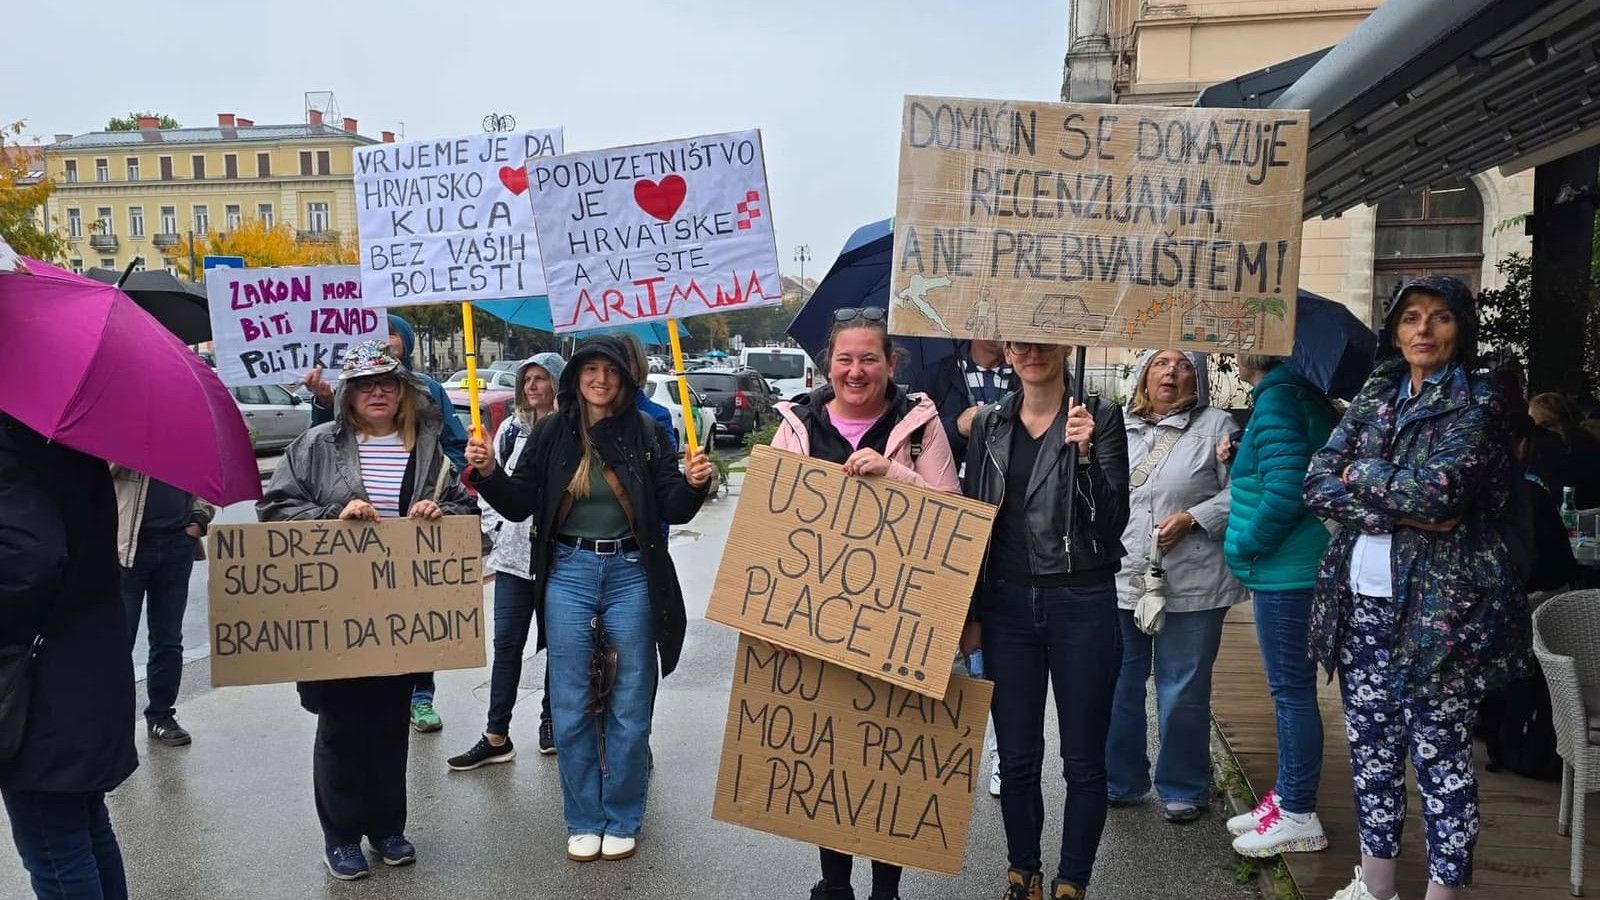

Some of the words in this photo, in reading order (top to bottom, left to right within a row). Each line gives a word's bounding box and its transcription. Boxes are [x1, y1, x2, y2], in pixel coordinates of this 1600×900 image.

[910, 101, 1038, 157] DOMAĆIN
[1059, 114, 1118, 160] SE
[358, 140, 469, 174] VRIJEME
[479, 137, 508, 162] JE
[524, 134, 556, 158] DA
[536, 140, 755, 191] PODUZETNIŠTVO
[364, 172, 482, 209] HRVATSKO
[571, 190, 608, 221] JE
[969, 167, 1223, 233] RECENZIJAMA,
[370, 242, 424, 271] BEZ
[447, 232, 526, 264] VAŠIH
[568, 212, 733, 255] HRVATSKE
[392, 262, 523, 297] BOLESTI
[574, 263, 592, 285] A
[606, 258, 632, 281] VI
[655, 248, 709, 272] STE
[901, 226, 925, 273] A
[932, 229, 976, 277] NE
[991, 229, 1288, 295] PREBIVALIŠTEM!
[229, 275, 311, 310] ZAKON
[322, 281, 362, 300] MOR
[310, 308, 378, 335] IZNAD
[768, 458, 992, 576] USIDRITE
[216, 529, 245, 559] NI
[268, 524, 391, 557] DRŽAVA,
[416, 525, 442, 554] NI
[225, 561, 339, 595] SUSJED
[372, 561, 396, 589] MI
[412, 553, 479, 587] NEĆE
[778, 528, 935, 617] SVOJE
[215, 619, 329, 655] BRANITI
[343, 618, 380, 649] DA
[386, 608, 479, 647] RADIM
[744, 645, 825, 702] MOJ
[853, 673, 971, 738] STAN,
[738, 699, 835, 765] MOJA
[856, 720, 973, 793] PRAVA
[733, 754, 742, 803] I
[766, 757, 948, 849] PRAVILA
